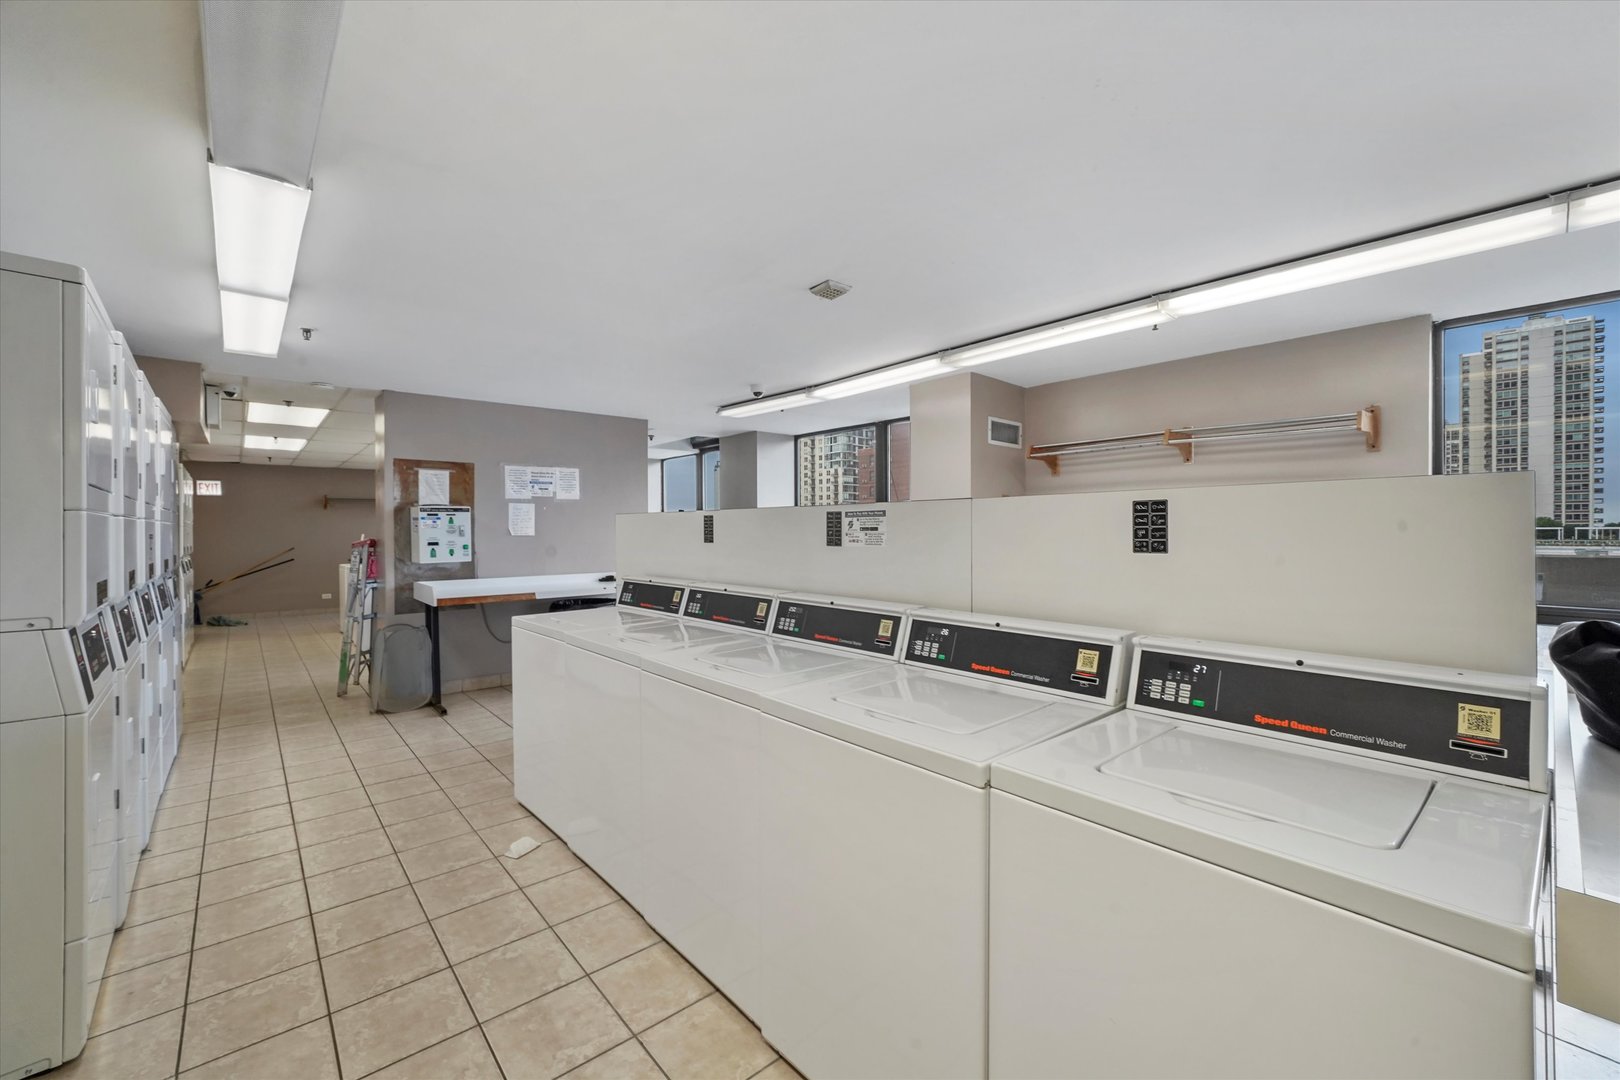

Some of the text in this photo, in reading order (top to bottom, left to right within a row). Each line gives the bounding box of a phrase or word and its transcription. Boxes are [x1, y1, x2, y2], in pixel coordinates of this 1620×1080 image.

[198, 482, 219, 494] EXIT
[971, 662, 990, 672] Speed
[1193, 664, 1207, 674] 27
[1254, 714, 1407, 750] Speed Queen Commercial Washer
